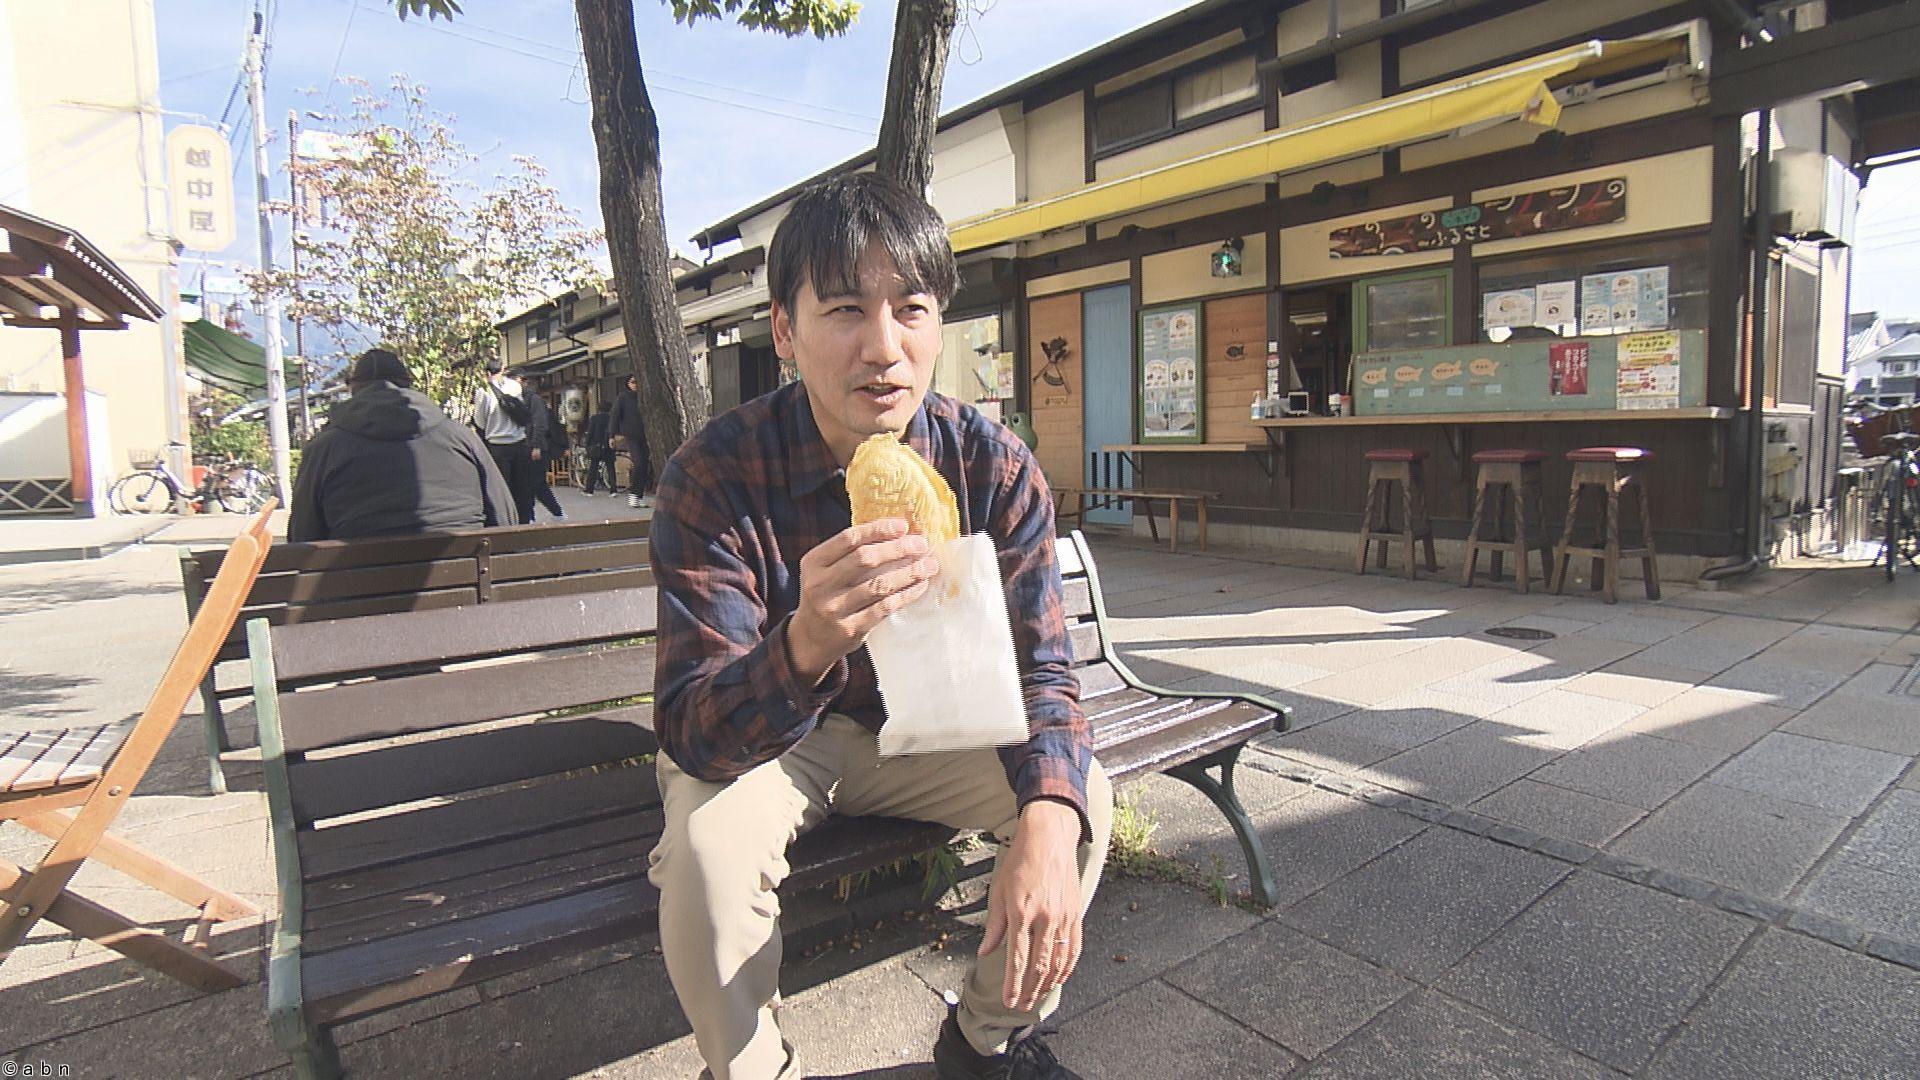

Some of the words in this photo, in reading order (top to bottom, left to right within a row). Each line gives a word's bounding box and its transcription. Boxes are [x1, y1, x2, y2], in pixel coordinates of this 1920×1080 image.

[186, 147, 216, 232] 越中屋
[1431, 225, 1490, 246] ふるさと
